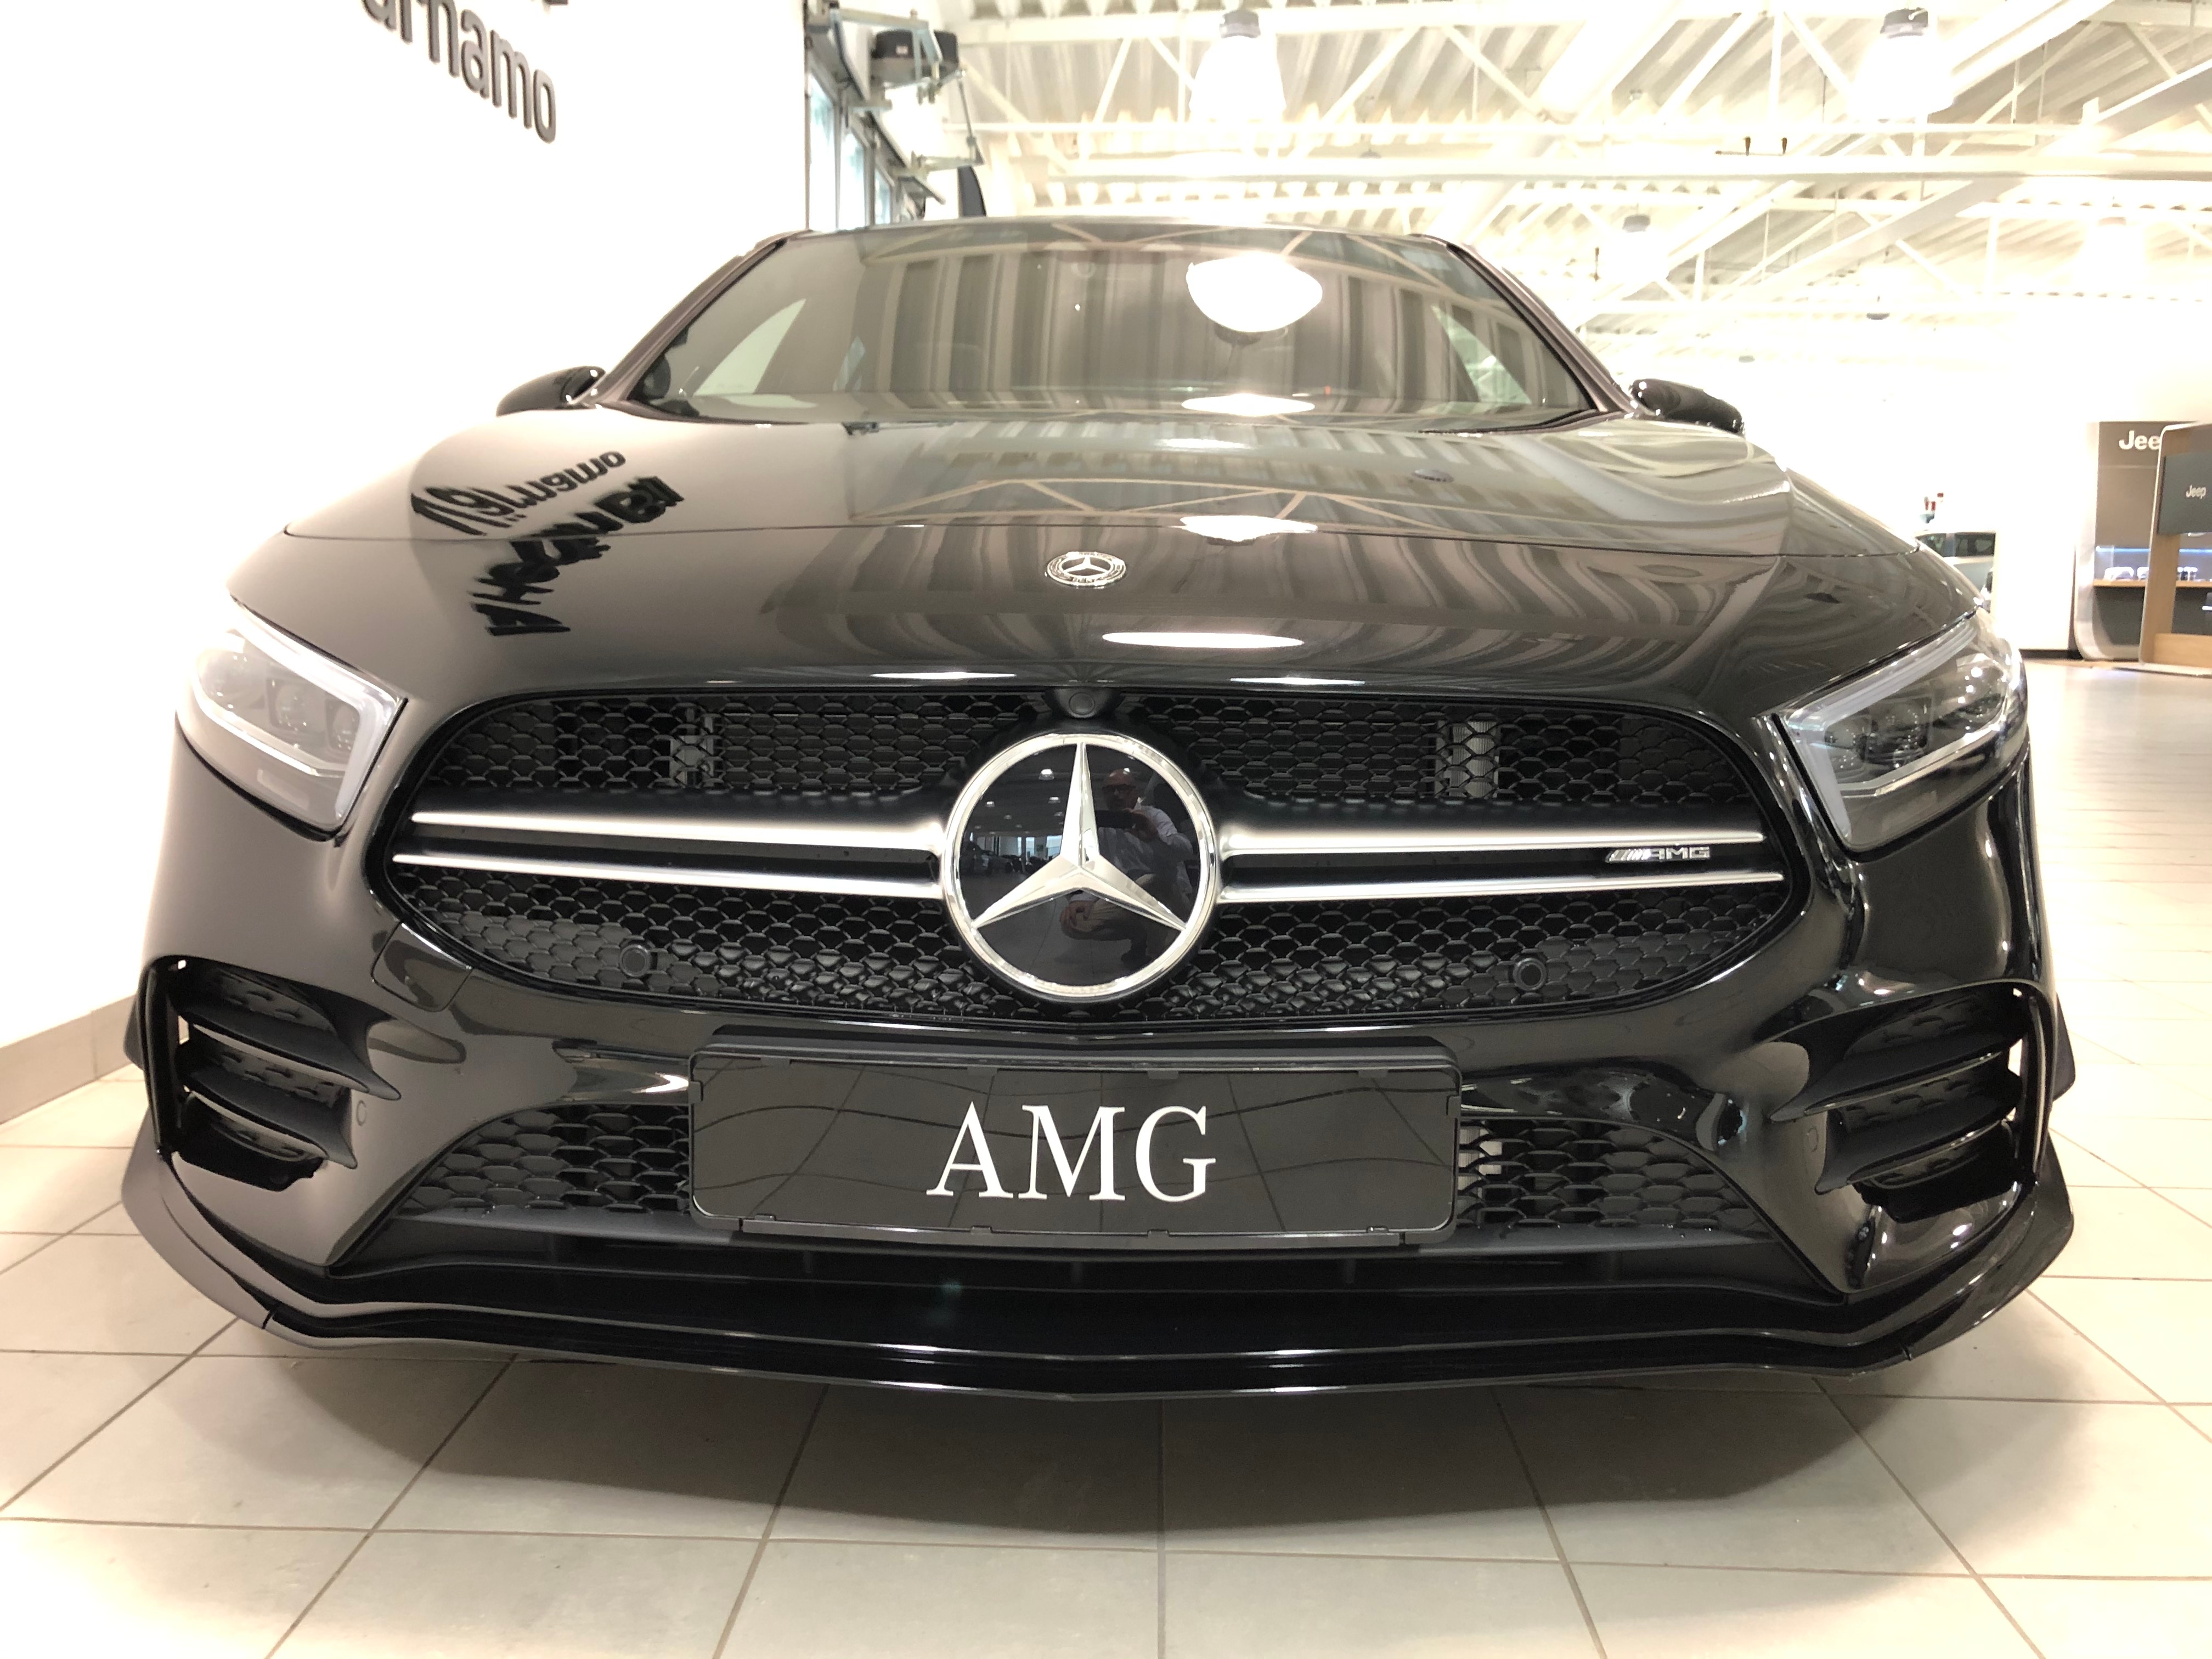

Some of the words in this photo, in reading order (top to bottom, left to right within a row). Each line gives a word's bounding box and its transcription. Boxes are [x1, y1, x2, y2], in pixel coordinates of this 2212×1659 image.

[2119, 430, 2161, 450] Jee
[2186, 484, 2207, 499] Jeep
[1649, 846, 1710, 861] AMG
[926, 1101, 1216, 1202] AMG
